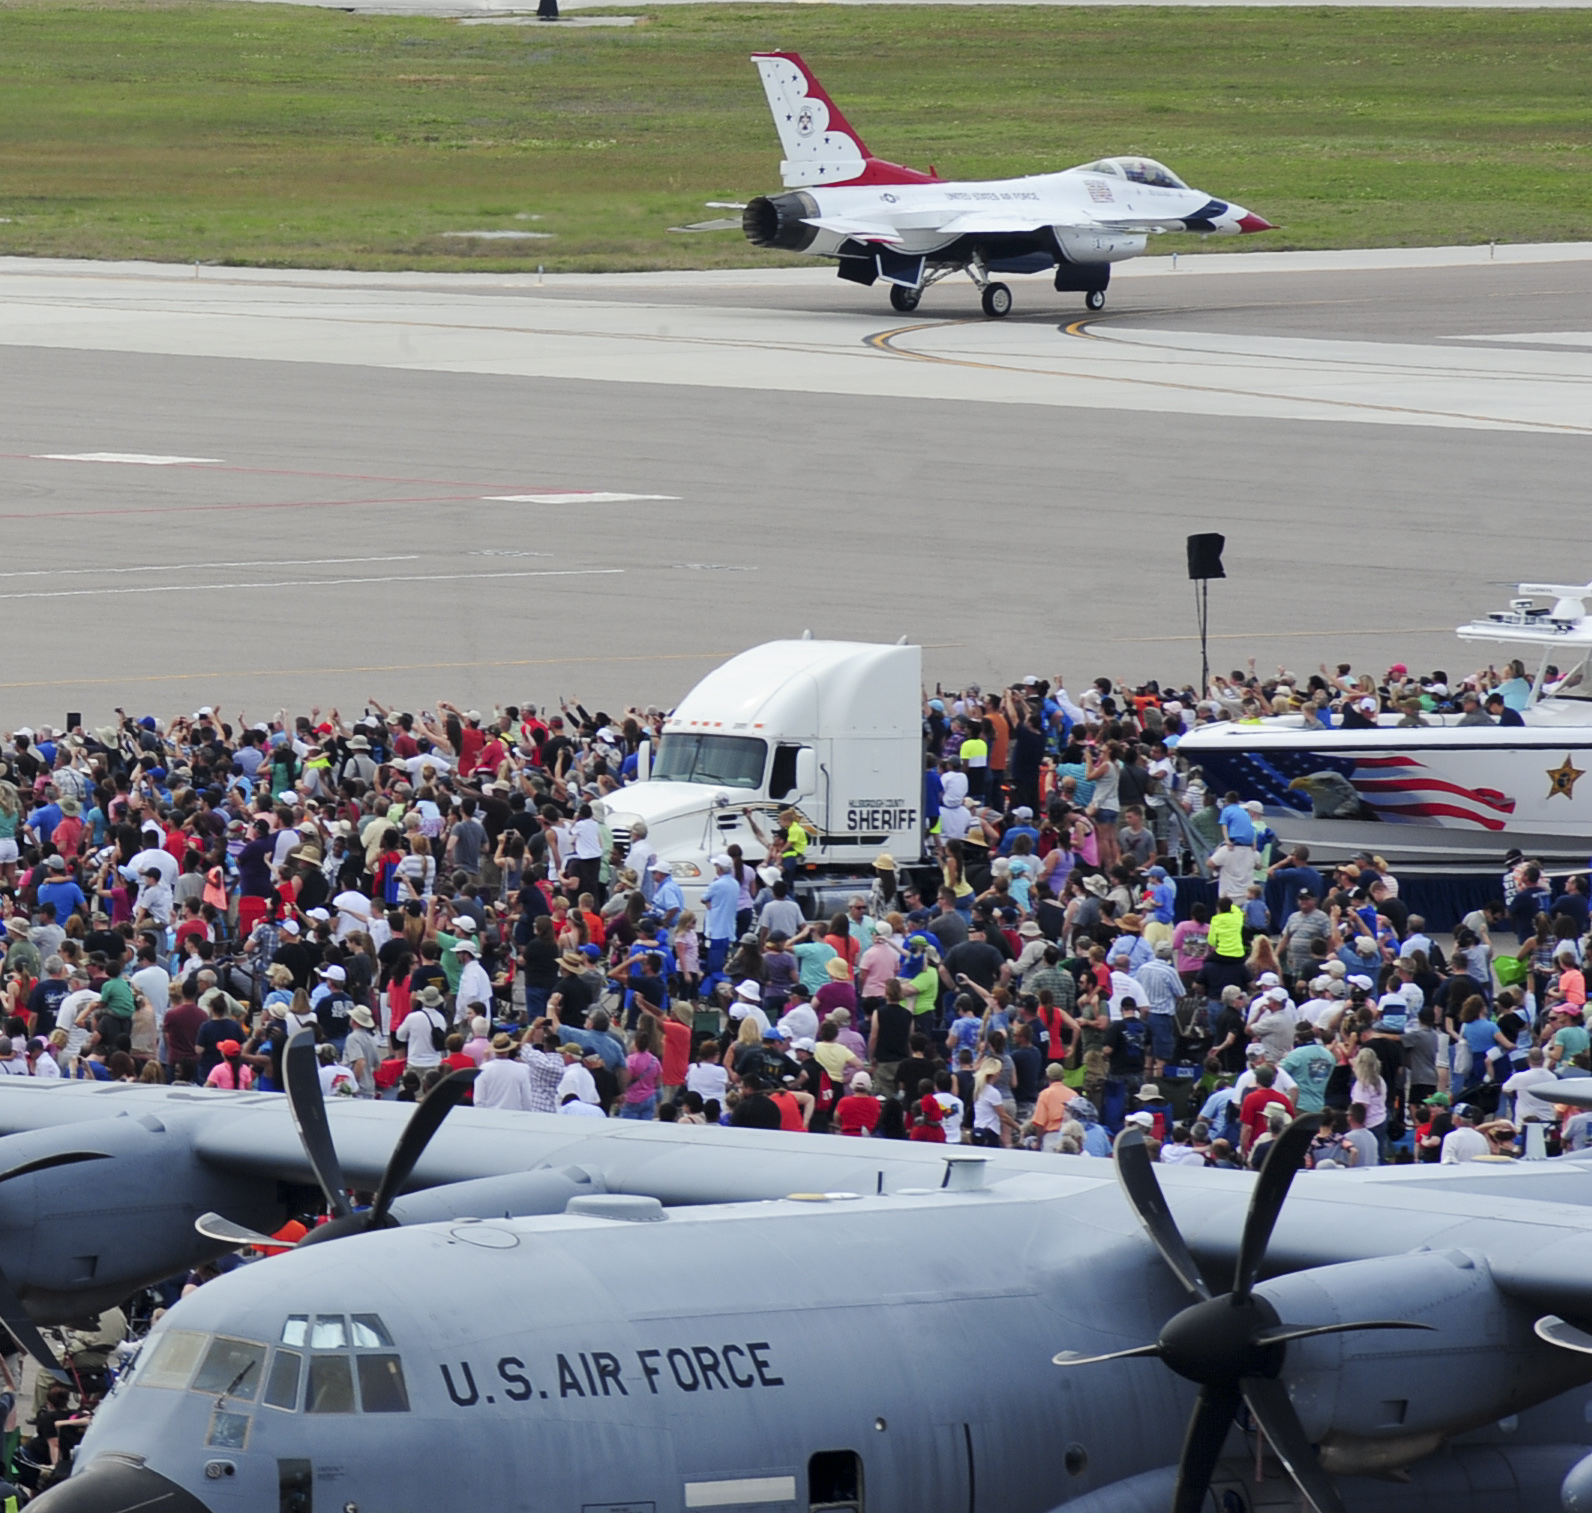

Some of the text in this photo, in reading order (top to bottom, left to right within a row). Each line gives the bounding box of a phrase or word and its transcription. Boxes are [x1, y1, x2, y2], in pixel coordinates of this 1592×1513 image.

[847, 809, 917, 830] SHERIFF
[440, 1342, 784, 1407] U.S. AIR FORCE
